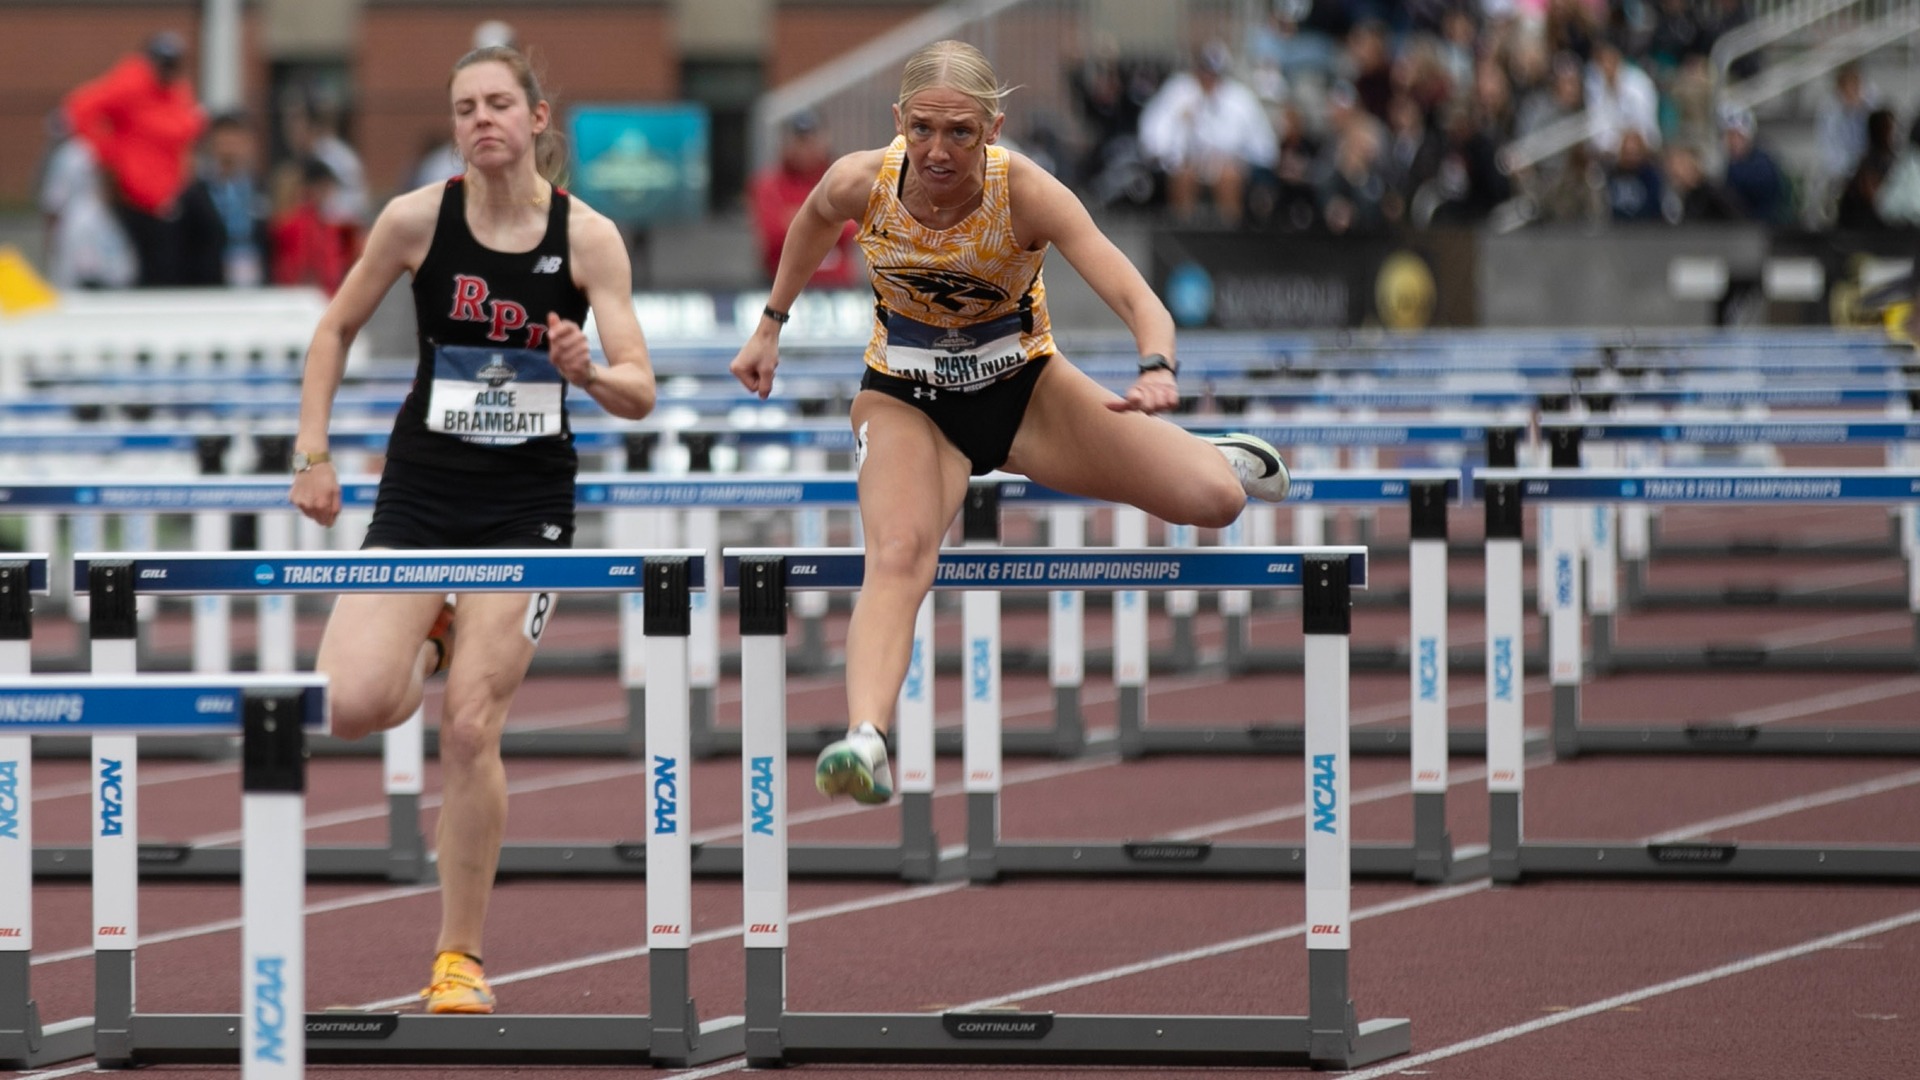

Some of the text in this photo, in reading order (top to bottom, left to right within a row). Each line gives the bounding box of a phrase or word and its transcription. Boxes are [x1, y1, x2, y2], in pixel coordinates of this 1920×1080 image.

[474, 390, 517, 408] ALICE
[443, 409, 545, 433] BRAMBATI
[140, 568, 168, 579] GILL
[283, 564, 524, 584] TRACK & FIELD CHAMPIONSHIPS
[608, 565, 636, 576] GILL
[791, 564, 818, 575] GILL
[937, 562, 1180, 580] TRACK & FIELD CHAMPIONSHIPS
[1267, 563, 1295, 574] GILL
[531, 593, 550, 640] 8
[100, 757, 123, 837] NCAA
[653, 755, 677, 835] NCAA
[750, 756, 774, 837] NCAA
[1313, 753, 1337, 834] NCAA
[98, 926, 127, 936] GILL
[652, 924, 681, 935] GILL
[750, 923, 779, 934] GILL
[1311, 924, 1342, 935] GILL
[254, 956, 286, 1065] NCAA
[304, 1022, 381, 1032] CONTINUUM
[957, 1022, 1036, 1032] CONTINUUM
